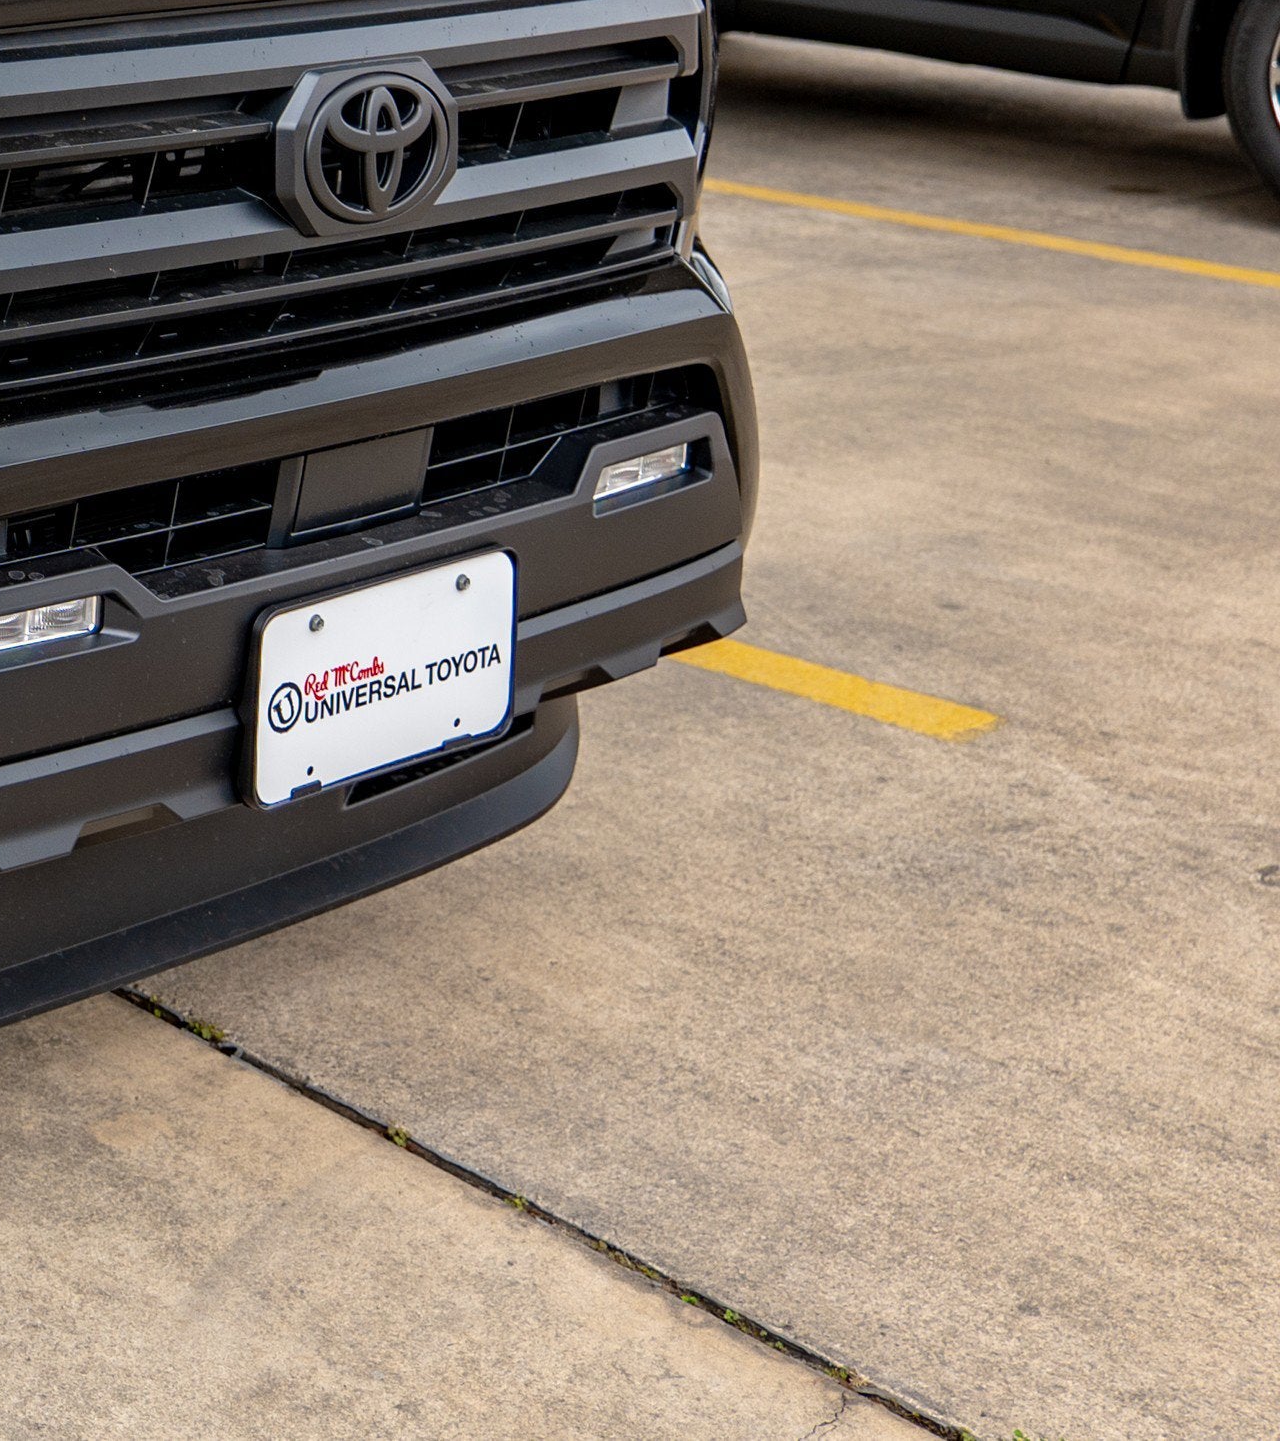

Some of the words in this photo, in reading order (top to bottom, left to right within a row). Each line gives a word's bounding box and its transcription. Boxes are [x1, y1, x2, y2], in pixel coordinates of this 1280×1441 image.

[304, 673, 329, 701] Red
[331, 656, 385, 689] McCombs
[304, 668, 422, 724] UNIVERSAL
[425, 643, 501, 685] TOYOTA
